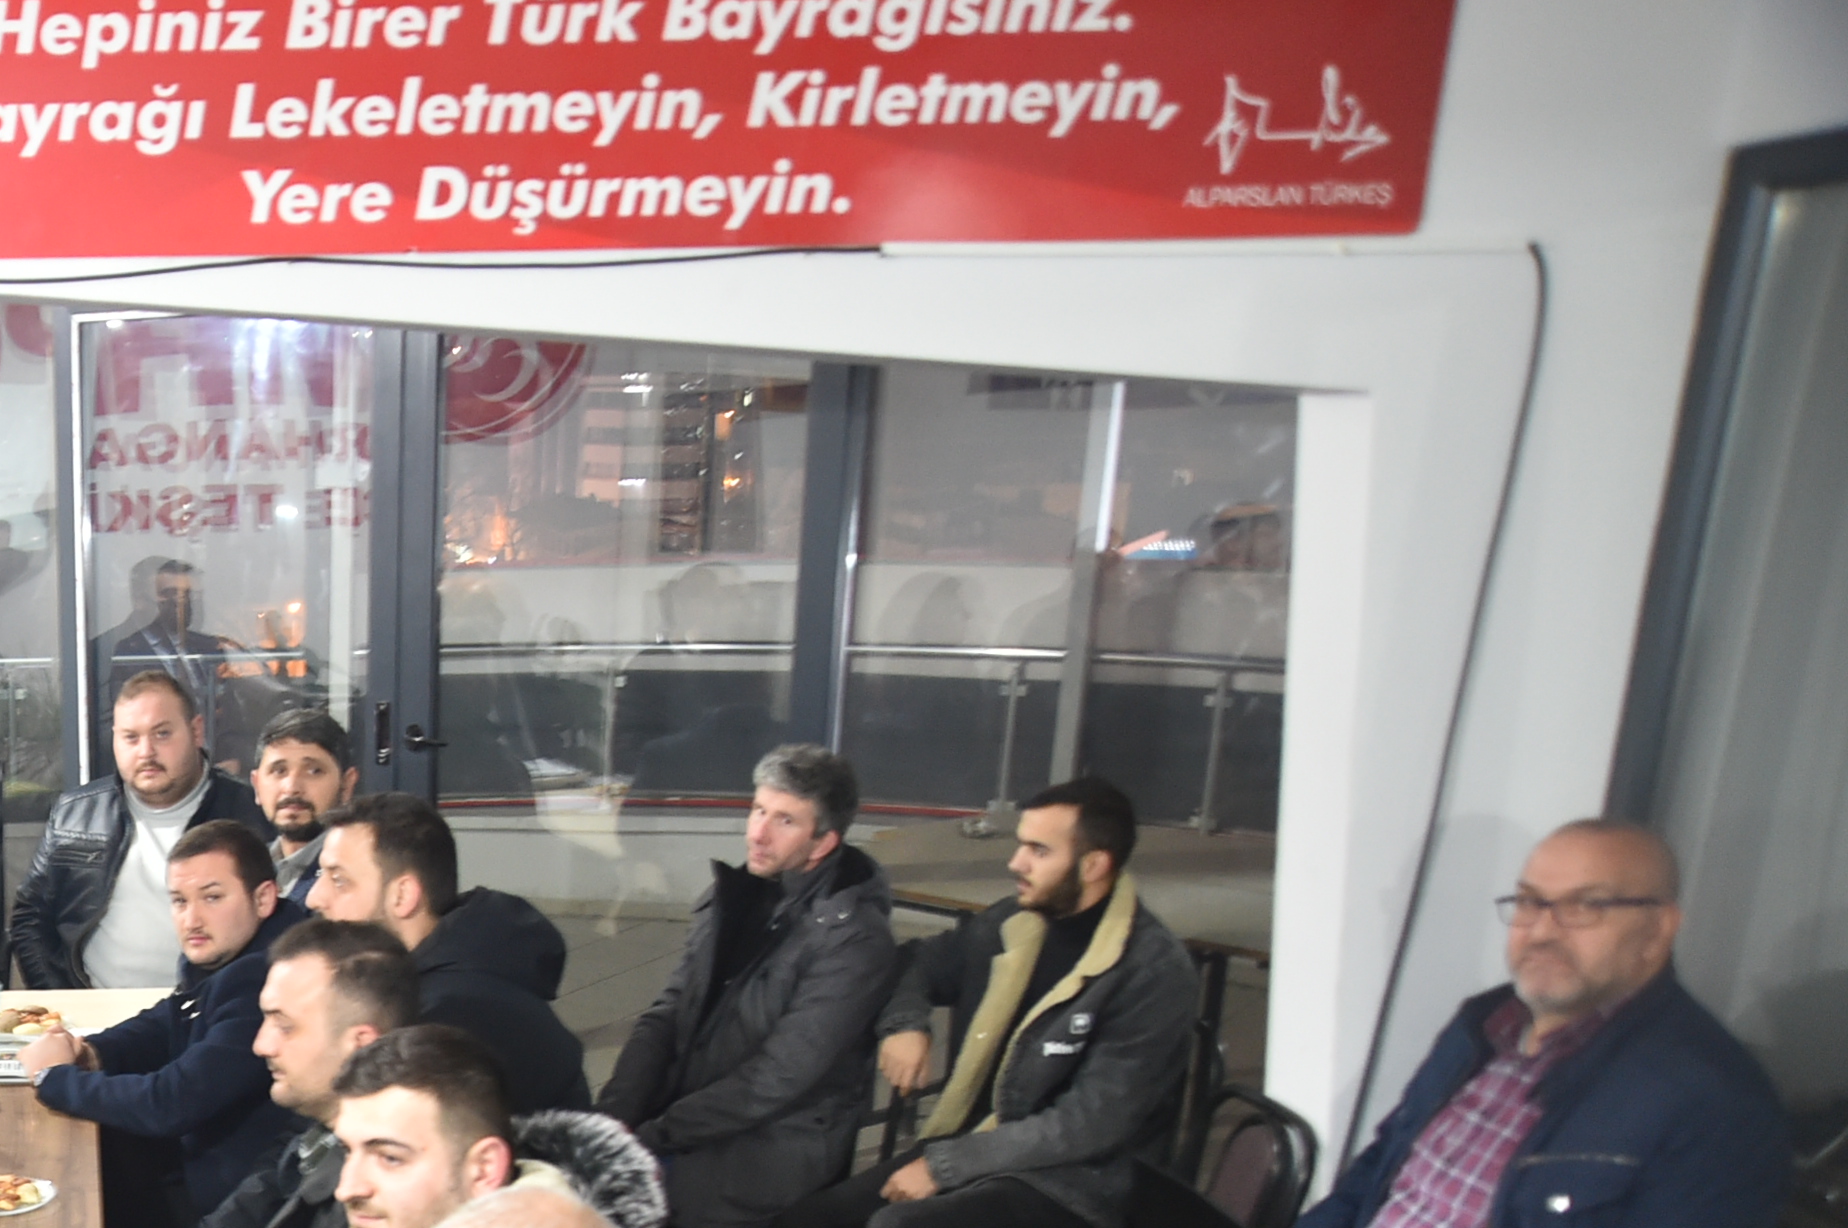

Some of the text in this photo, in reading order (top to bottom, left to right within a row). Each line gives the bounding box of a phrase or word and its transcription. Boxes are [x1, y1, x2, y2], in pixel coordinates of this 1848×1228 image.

[286, 0, 460, 49] Birer
[229, 73, 722, 146] Lekeletmeyin,
[747, 63, 1179, 137] Kirletmeyin,
[242, 158, 851, 235] Yere Düşürmeyin.
[1182, 184, 1304, 208] ALPARSLAN
